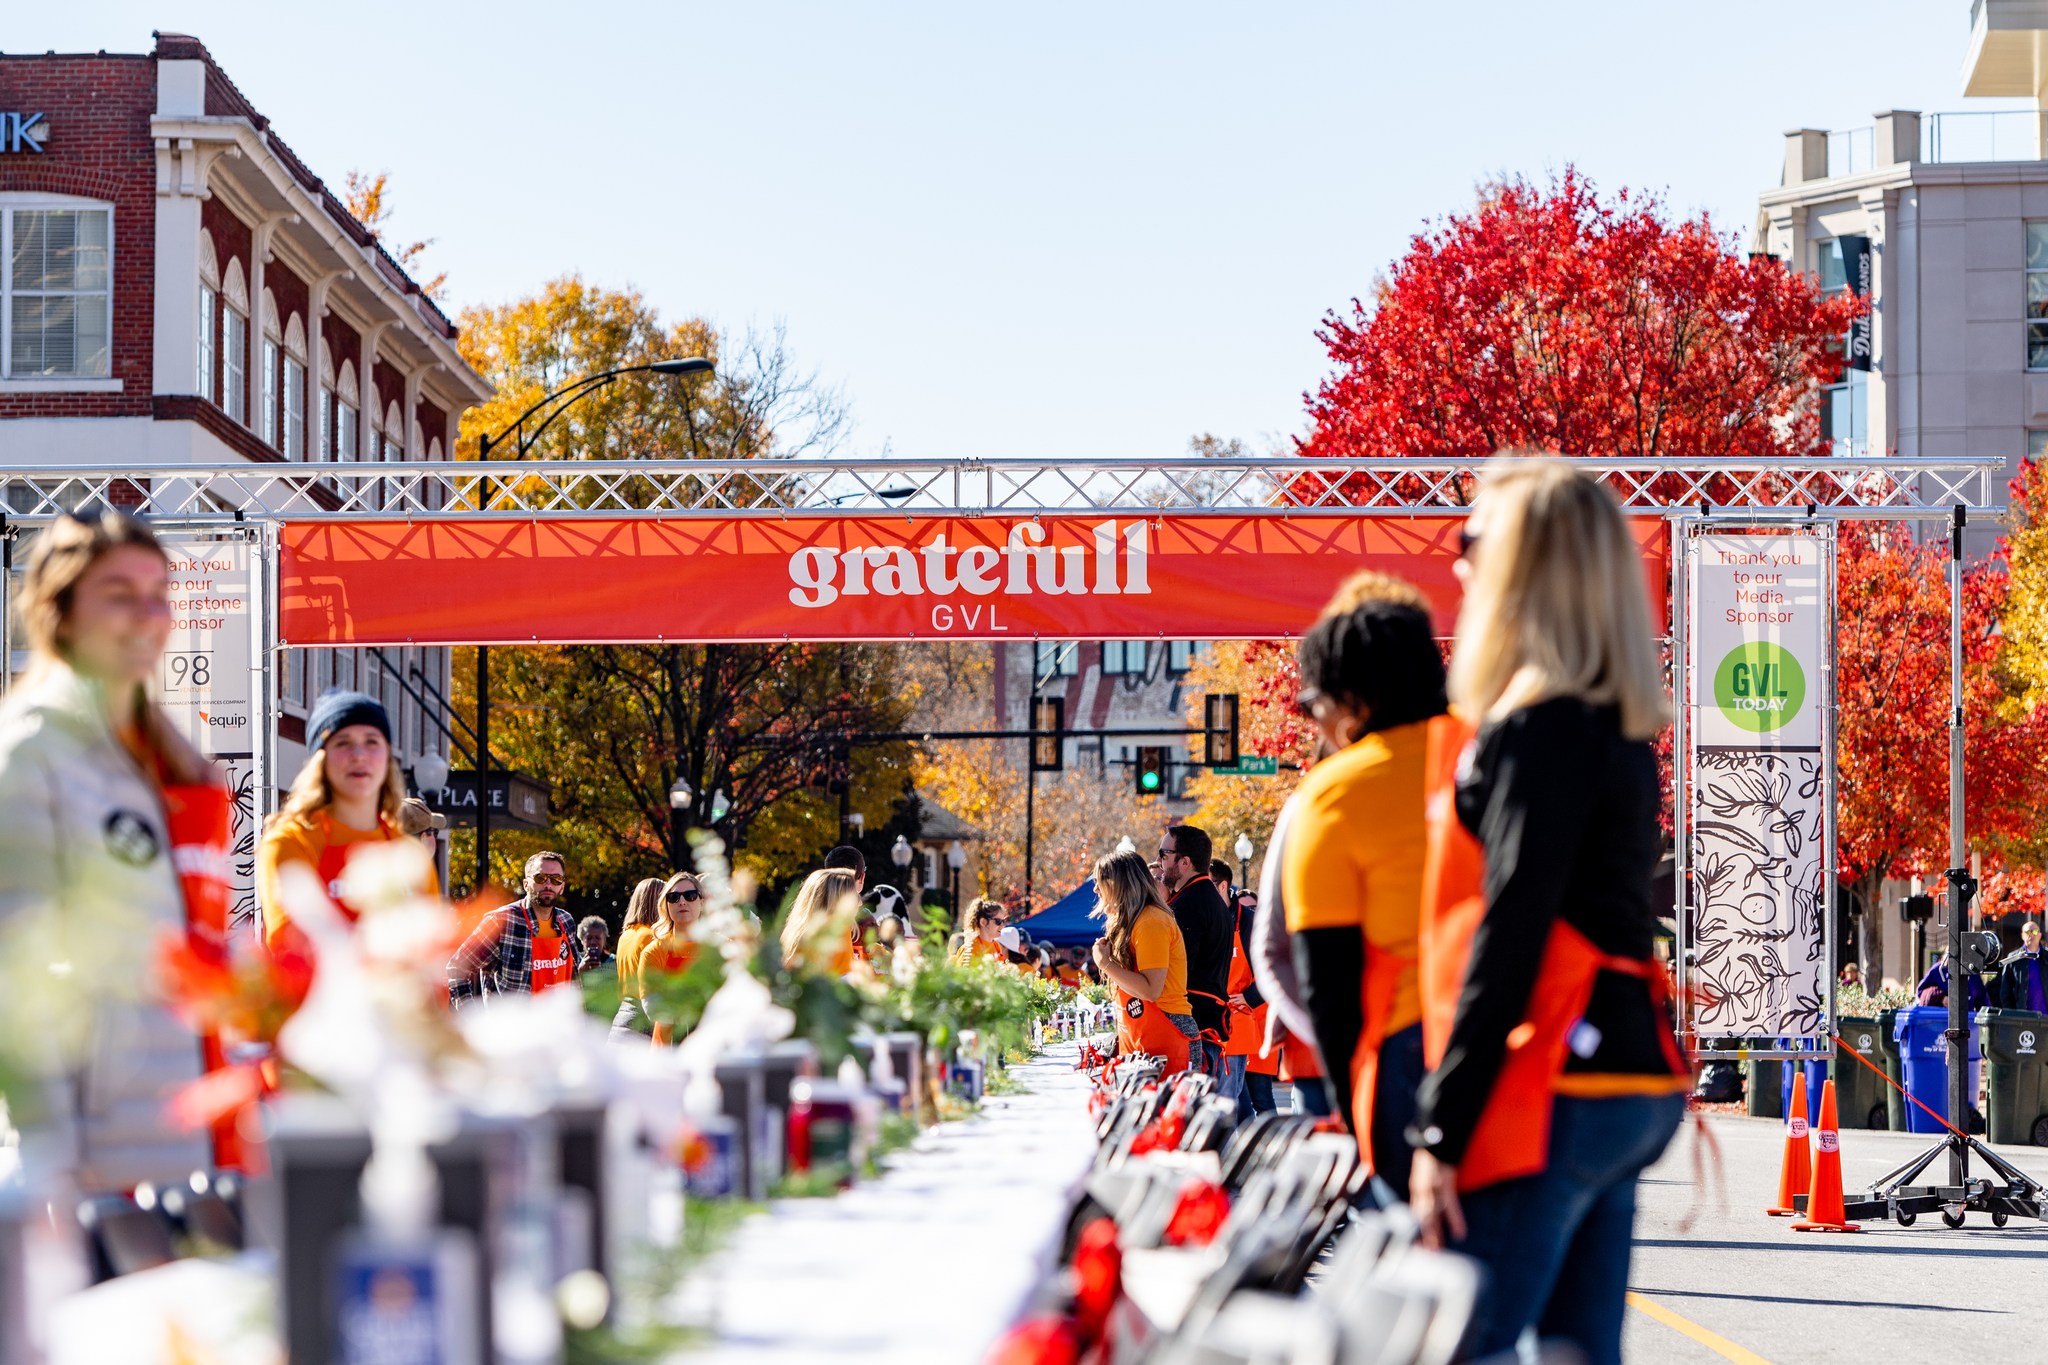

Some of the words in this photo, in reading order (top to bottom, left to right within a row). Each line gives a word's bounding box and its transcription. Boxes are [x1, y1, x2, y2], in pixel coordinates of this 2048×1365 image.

[1859, 253, 1870, 297] RANDS
[168, 558, 198, 572] ank
[202, 560, 231, 574] you
[788, 518, 1152, 608] gratefull
[1718, 550, 1769, 565] Thank
[1771, 554, 1801, 568] you
[1733, 570, 1750, 584] to
[1755, 573, 1782, 584] our
[185, 580, 213, 591] our
[168, 596, 241, 611] nerstone
[1736, 589, 1784, 604] Media
[931, 604, 1009, 631] GVL
[1726, 608, 1794, 625] Sponsor
[171, 655, 210, 686] 98
[1732, 662, 1788, 697] GVL
[1732, 698, 1788, 711] TODAY
[209, 713, 247, 728] equip
[1241, 758, 1266, 771] Park
[437, 786, 504, 807] PLAE
[1127, 998, 1142, 1012] ASK
[1131, 1007, 1142, 1018] ME
